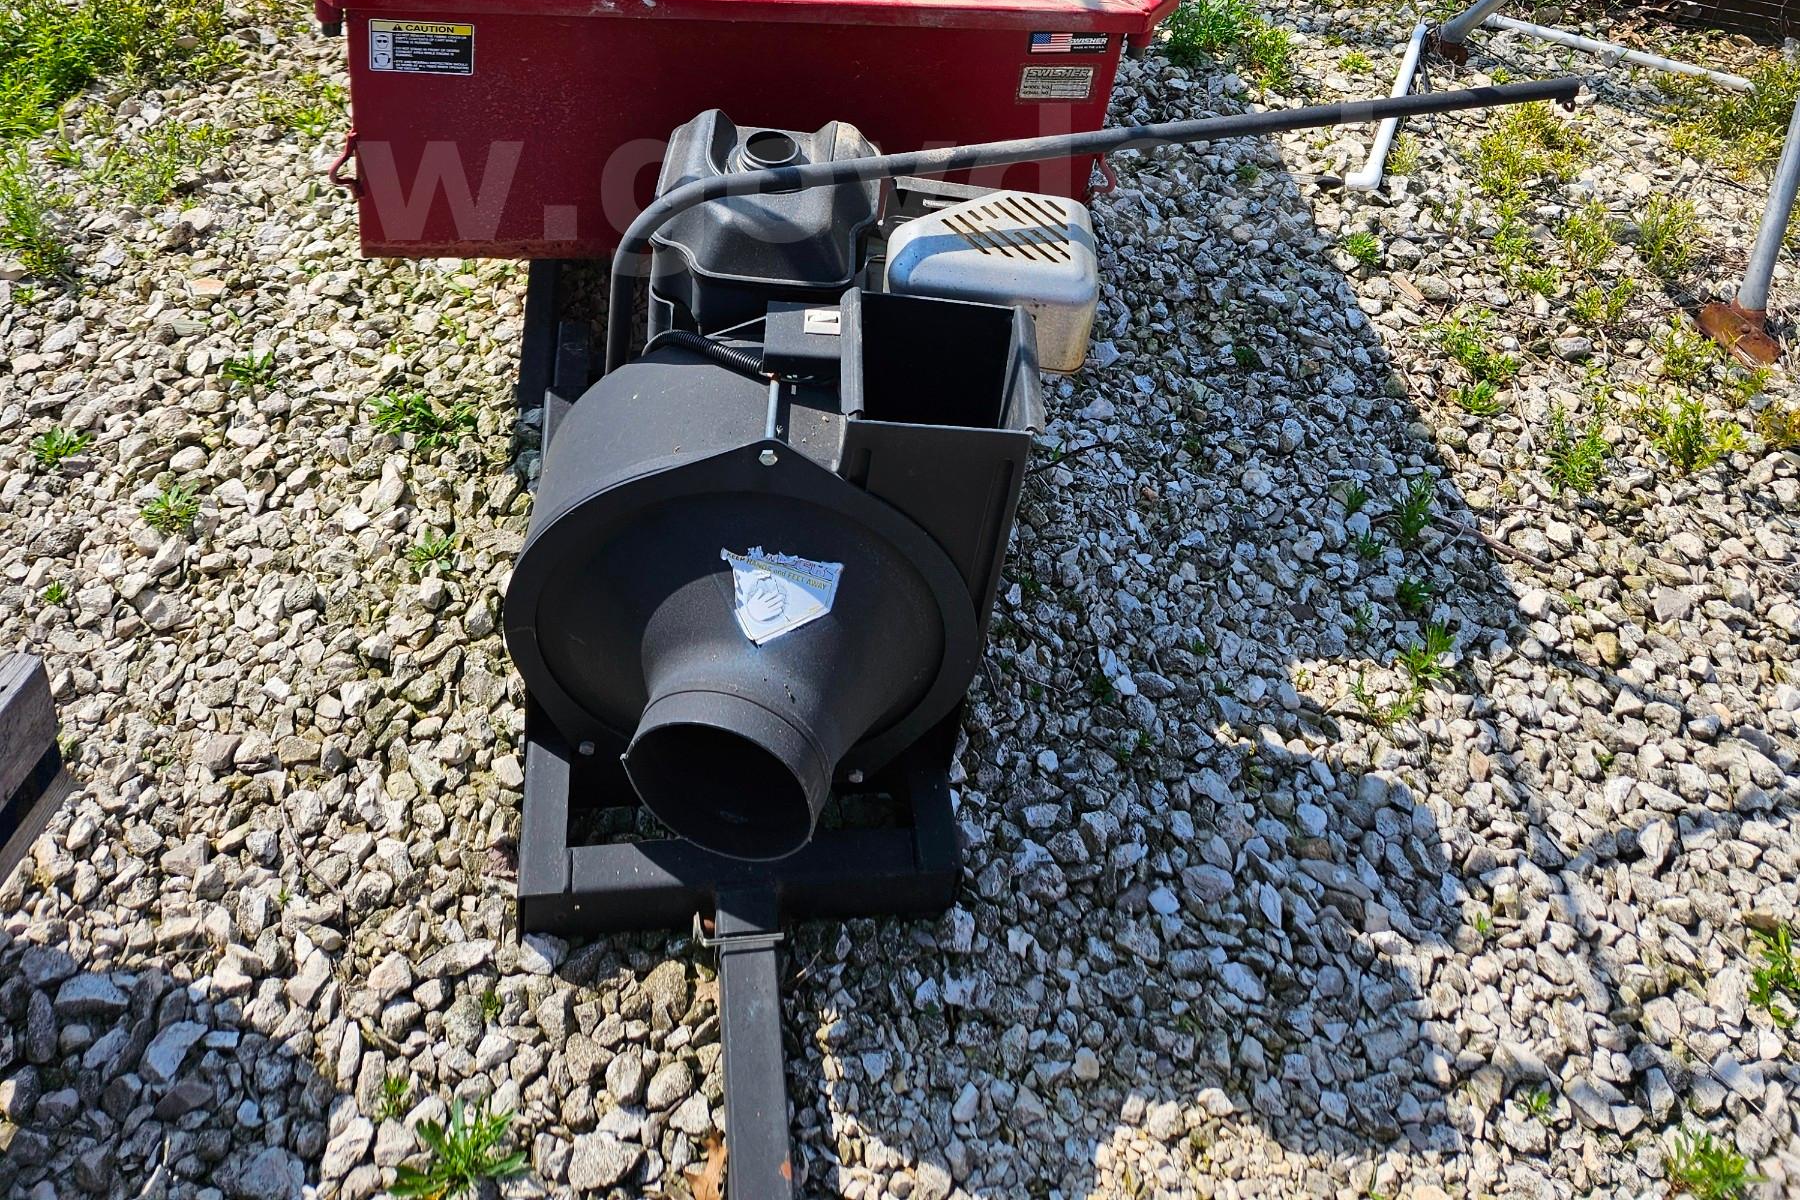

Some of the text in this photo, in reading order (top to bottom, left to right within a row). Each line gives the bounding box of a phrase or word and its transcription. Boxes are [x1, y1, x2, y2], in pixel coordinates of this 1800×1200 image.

[405, 24, 455, 33] CAUTION
[1067, 37, 1108, 45] SWISHER
[1027, 69, 1089, 78] SWISHER
[747, 559, 772, 573] HANDS
[788, 571, 805, 582] FEET
[806, 577, 827, 590] AWAY
